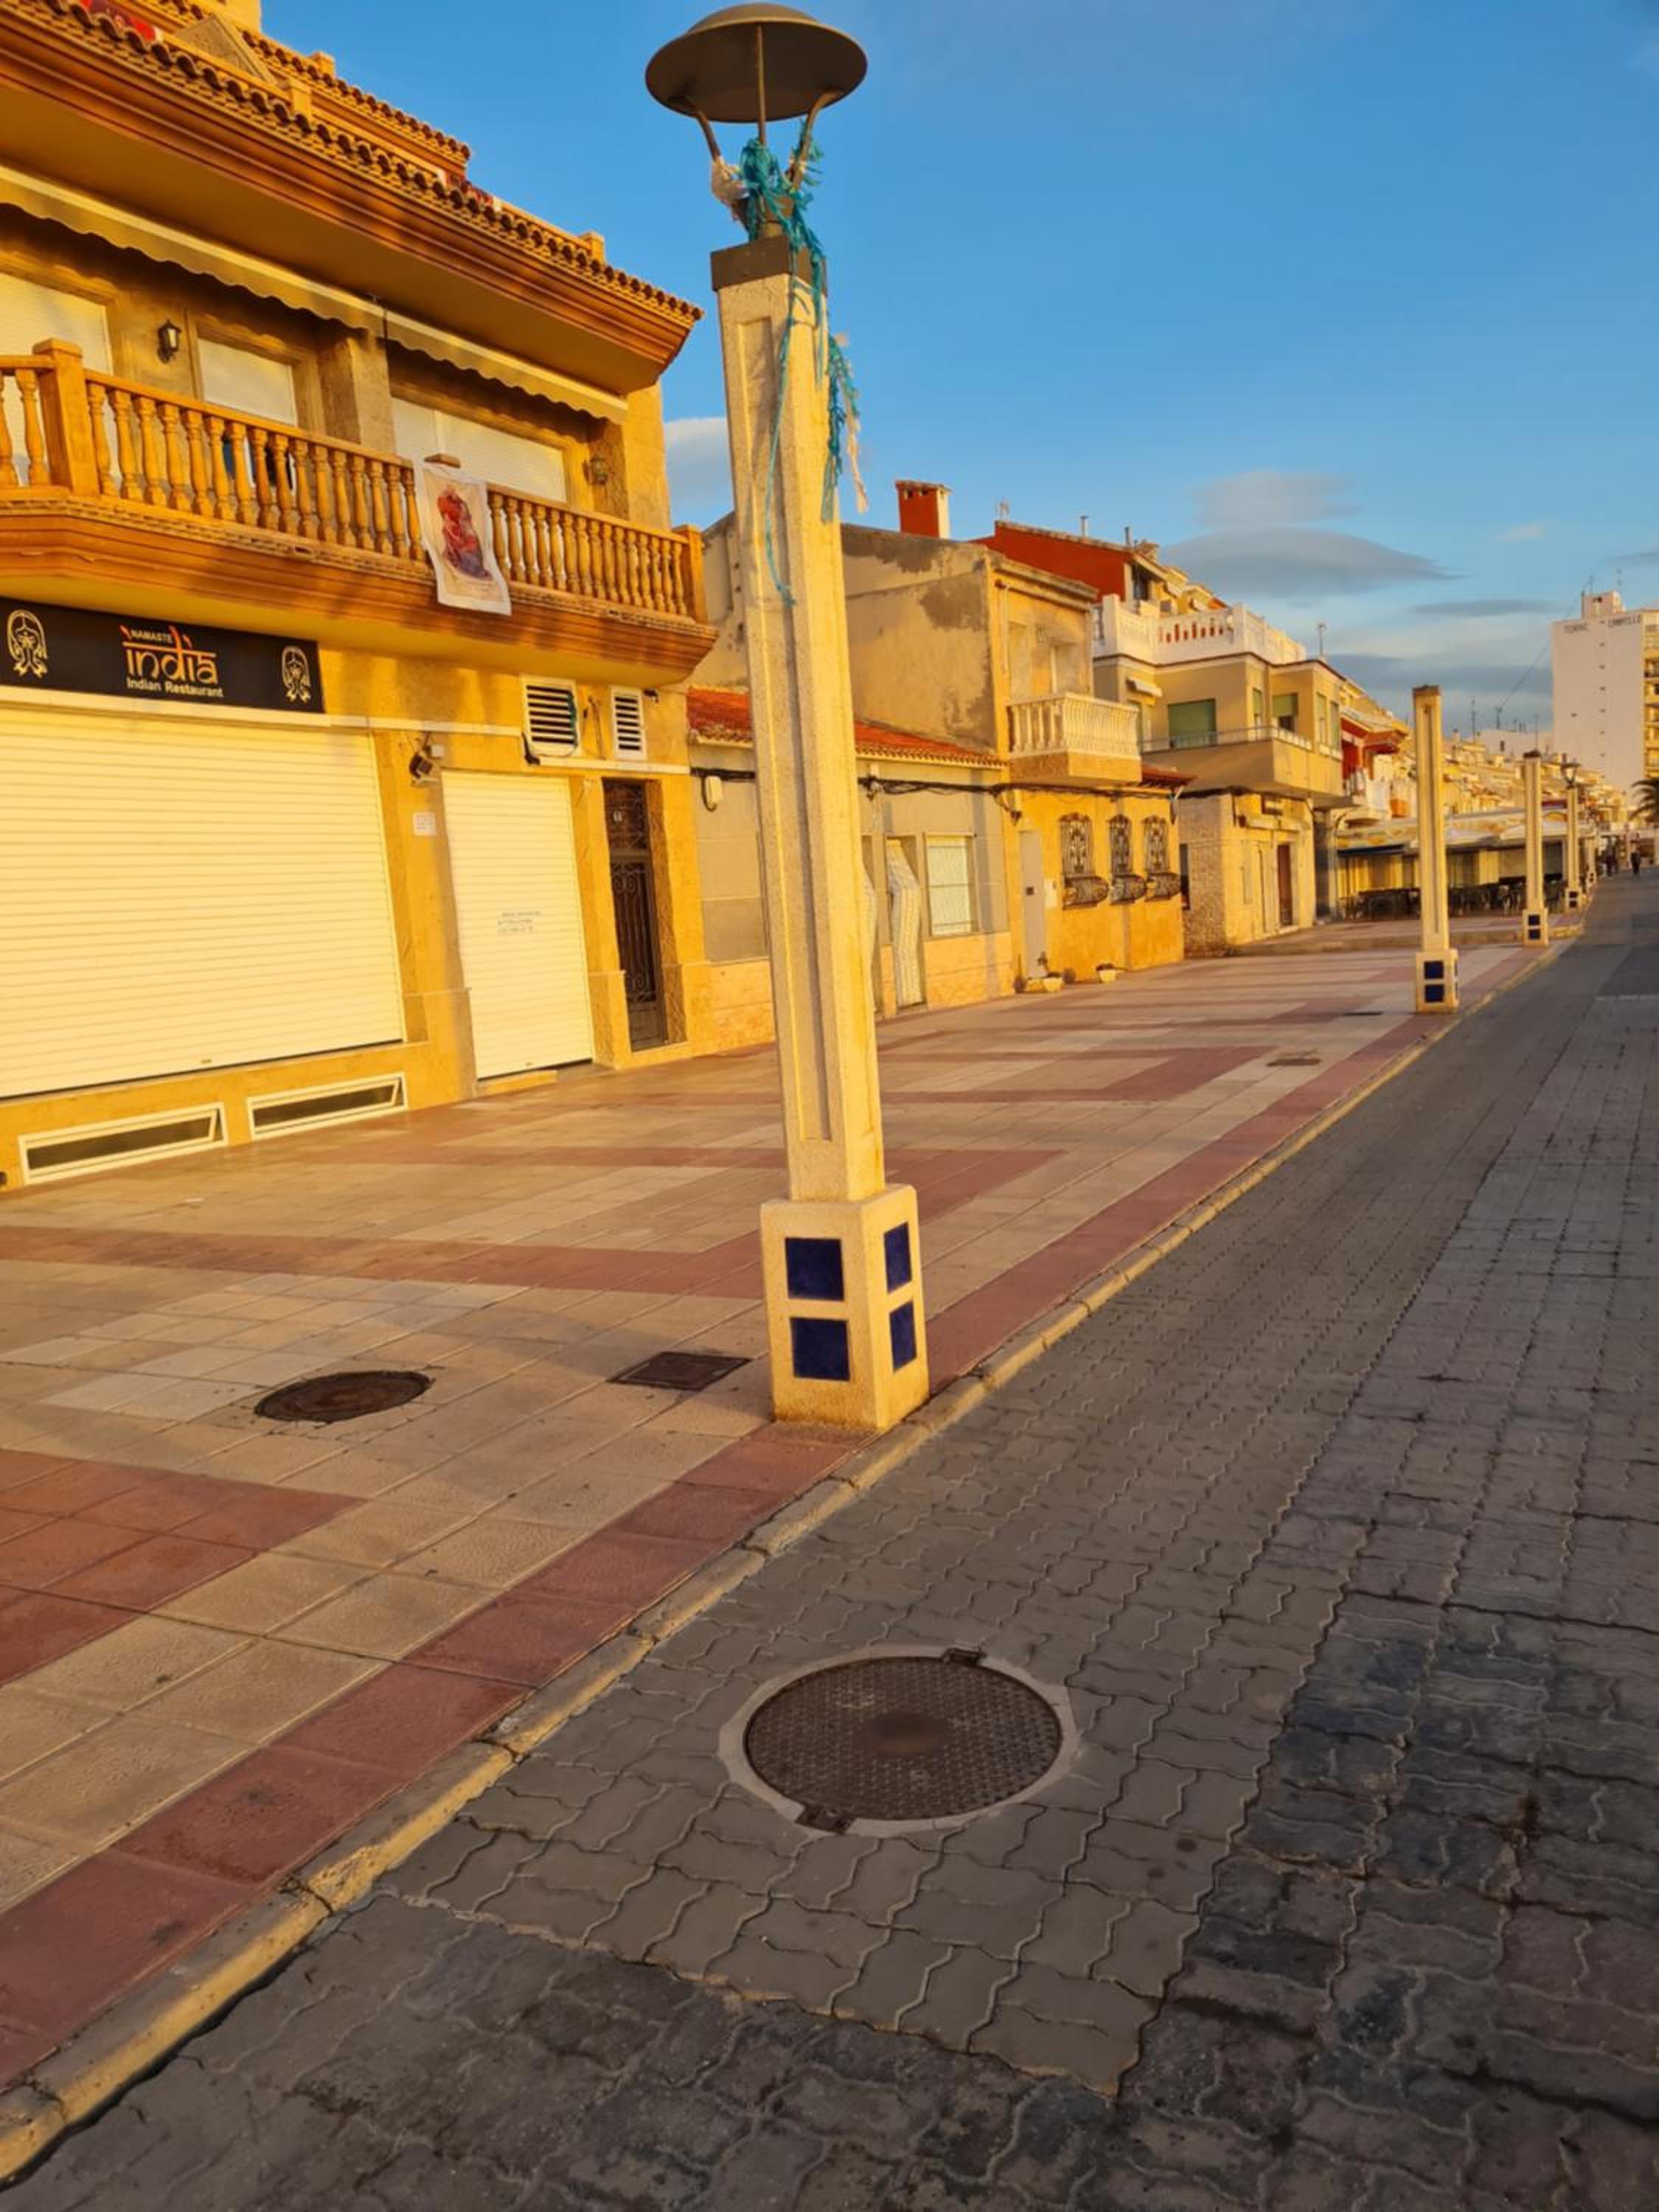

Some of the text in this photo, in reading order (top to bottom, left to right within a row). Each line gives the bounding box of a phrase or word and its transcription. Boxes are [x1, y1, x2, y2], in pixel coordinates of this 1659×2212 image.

[131, 629, 173, 643] NAMASTE
[126, 678, 161, 691] Indian
[164, 681, 224, 698] Restaurant
